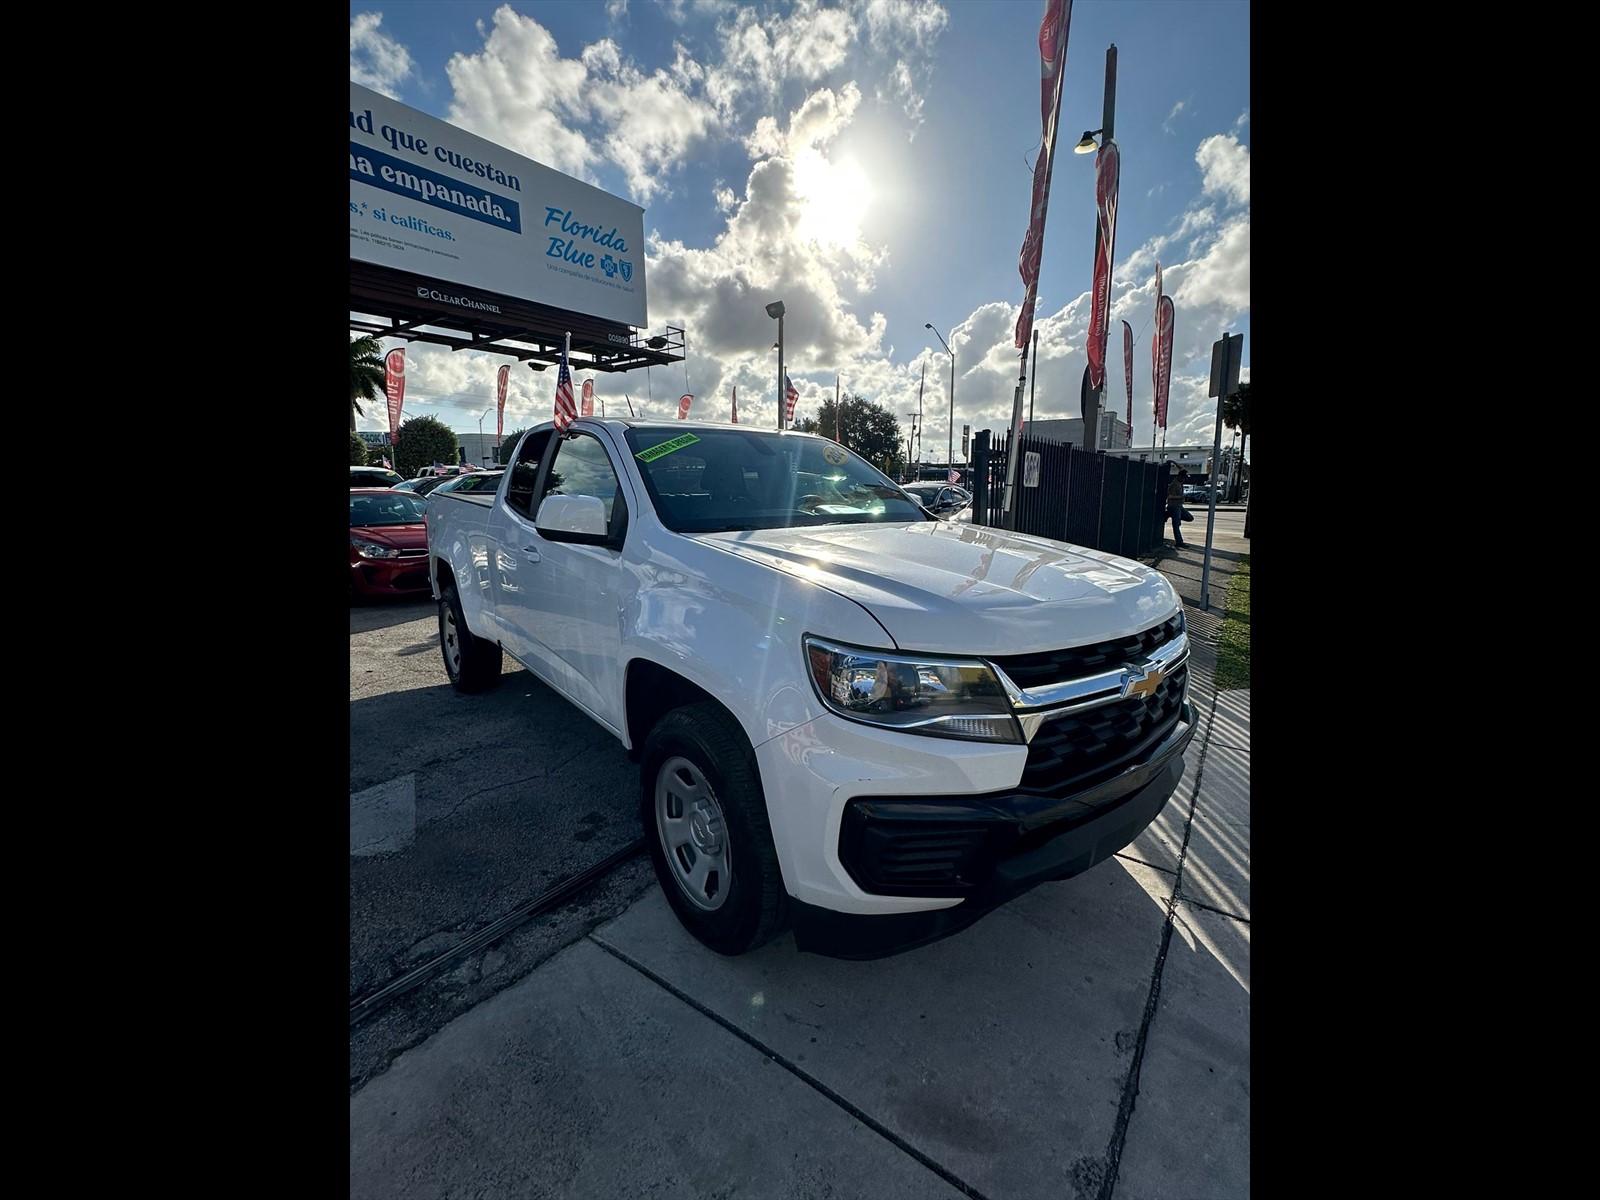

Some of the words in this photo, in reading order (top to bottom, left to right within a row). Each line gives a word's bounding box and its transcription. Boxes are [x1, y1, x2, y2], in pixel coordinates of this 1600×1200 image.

[381, 124, 429, 155] que
[434, 146, 521, 192] cuestan
[380, 165, 512, 223] empanada.
[373, 207, 387, 222] si
[390, 215, 456, 242] calificas.
[545, 206, 628, 253] Florida
[546, 237, 595, 268] Blue
